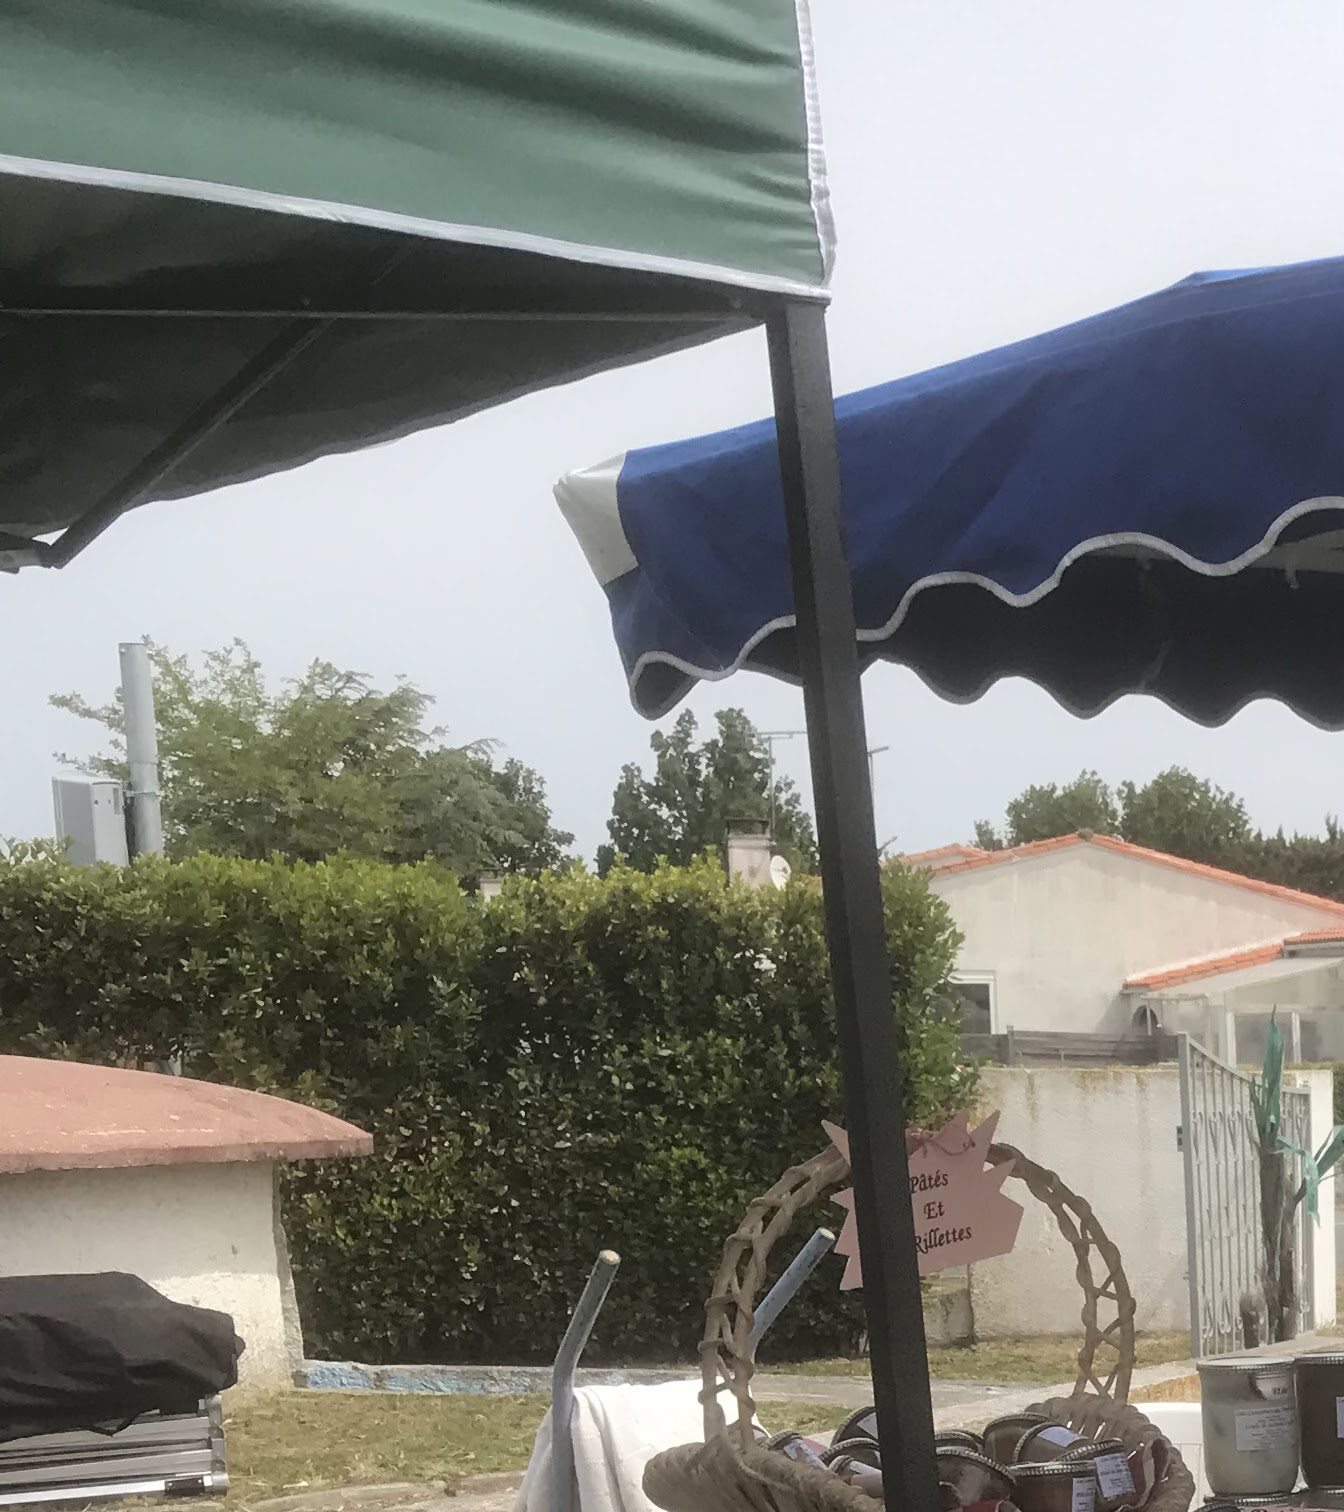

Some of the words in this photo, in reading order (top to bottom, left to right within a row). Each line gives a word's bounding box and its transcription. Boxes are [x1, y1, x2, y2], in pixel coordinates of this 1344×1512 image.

[909, 1169, 949, 1195] Pâtés
[923, 1201, 945, 1220] Et
[914, 1225, 973, 1255] Rillettes
